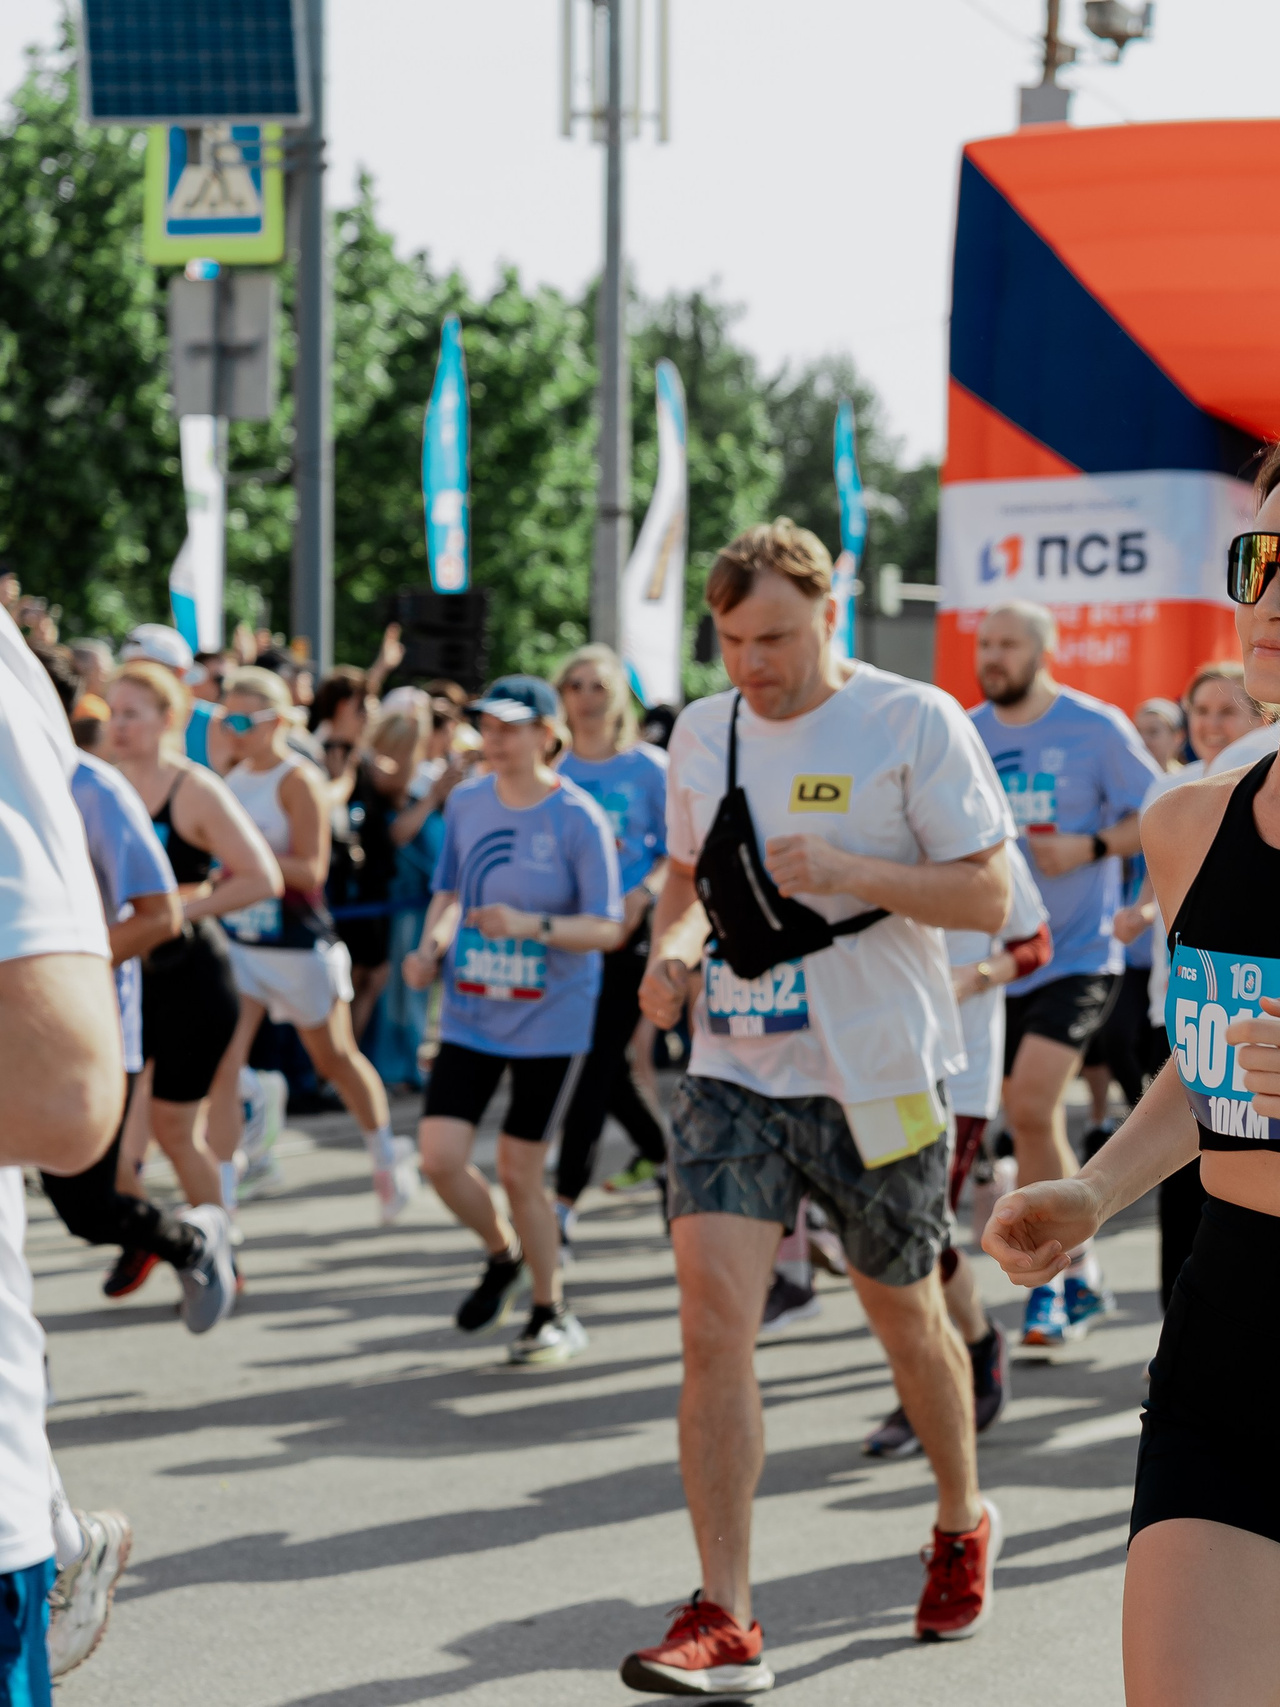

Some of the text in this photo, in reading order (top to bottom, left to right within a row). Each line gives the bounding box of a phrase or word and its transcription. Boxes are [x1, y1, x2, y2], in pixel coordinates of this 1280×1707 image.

[1037, 531, 1147, 579] ПСБ
[1181, 966, 1198, 982] ПСБ
[1230, 963, 1262, 1001] 10
[1208, 1096, 1270, 1140] 10KM
